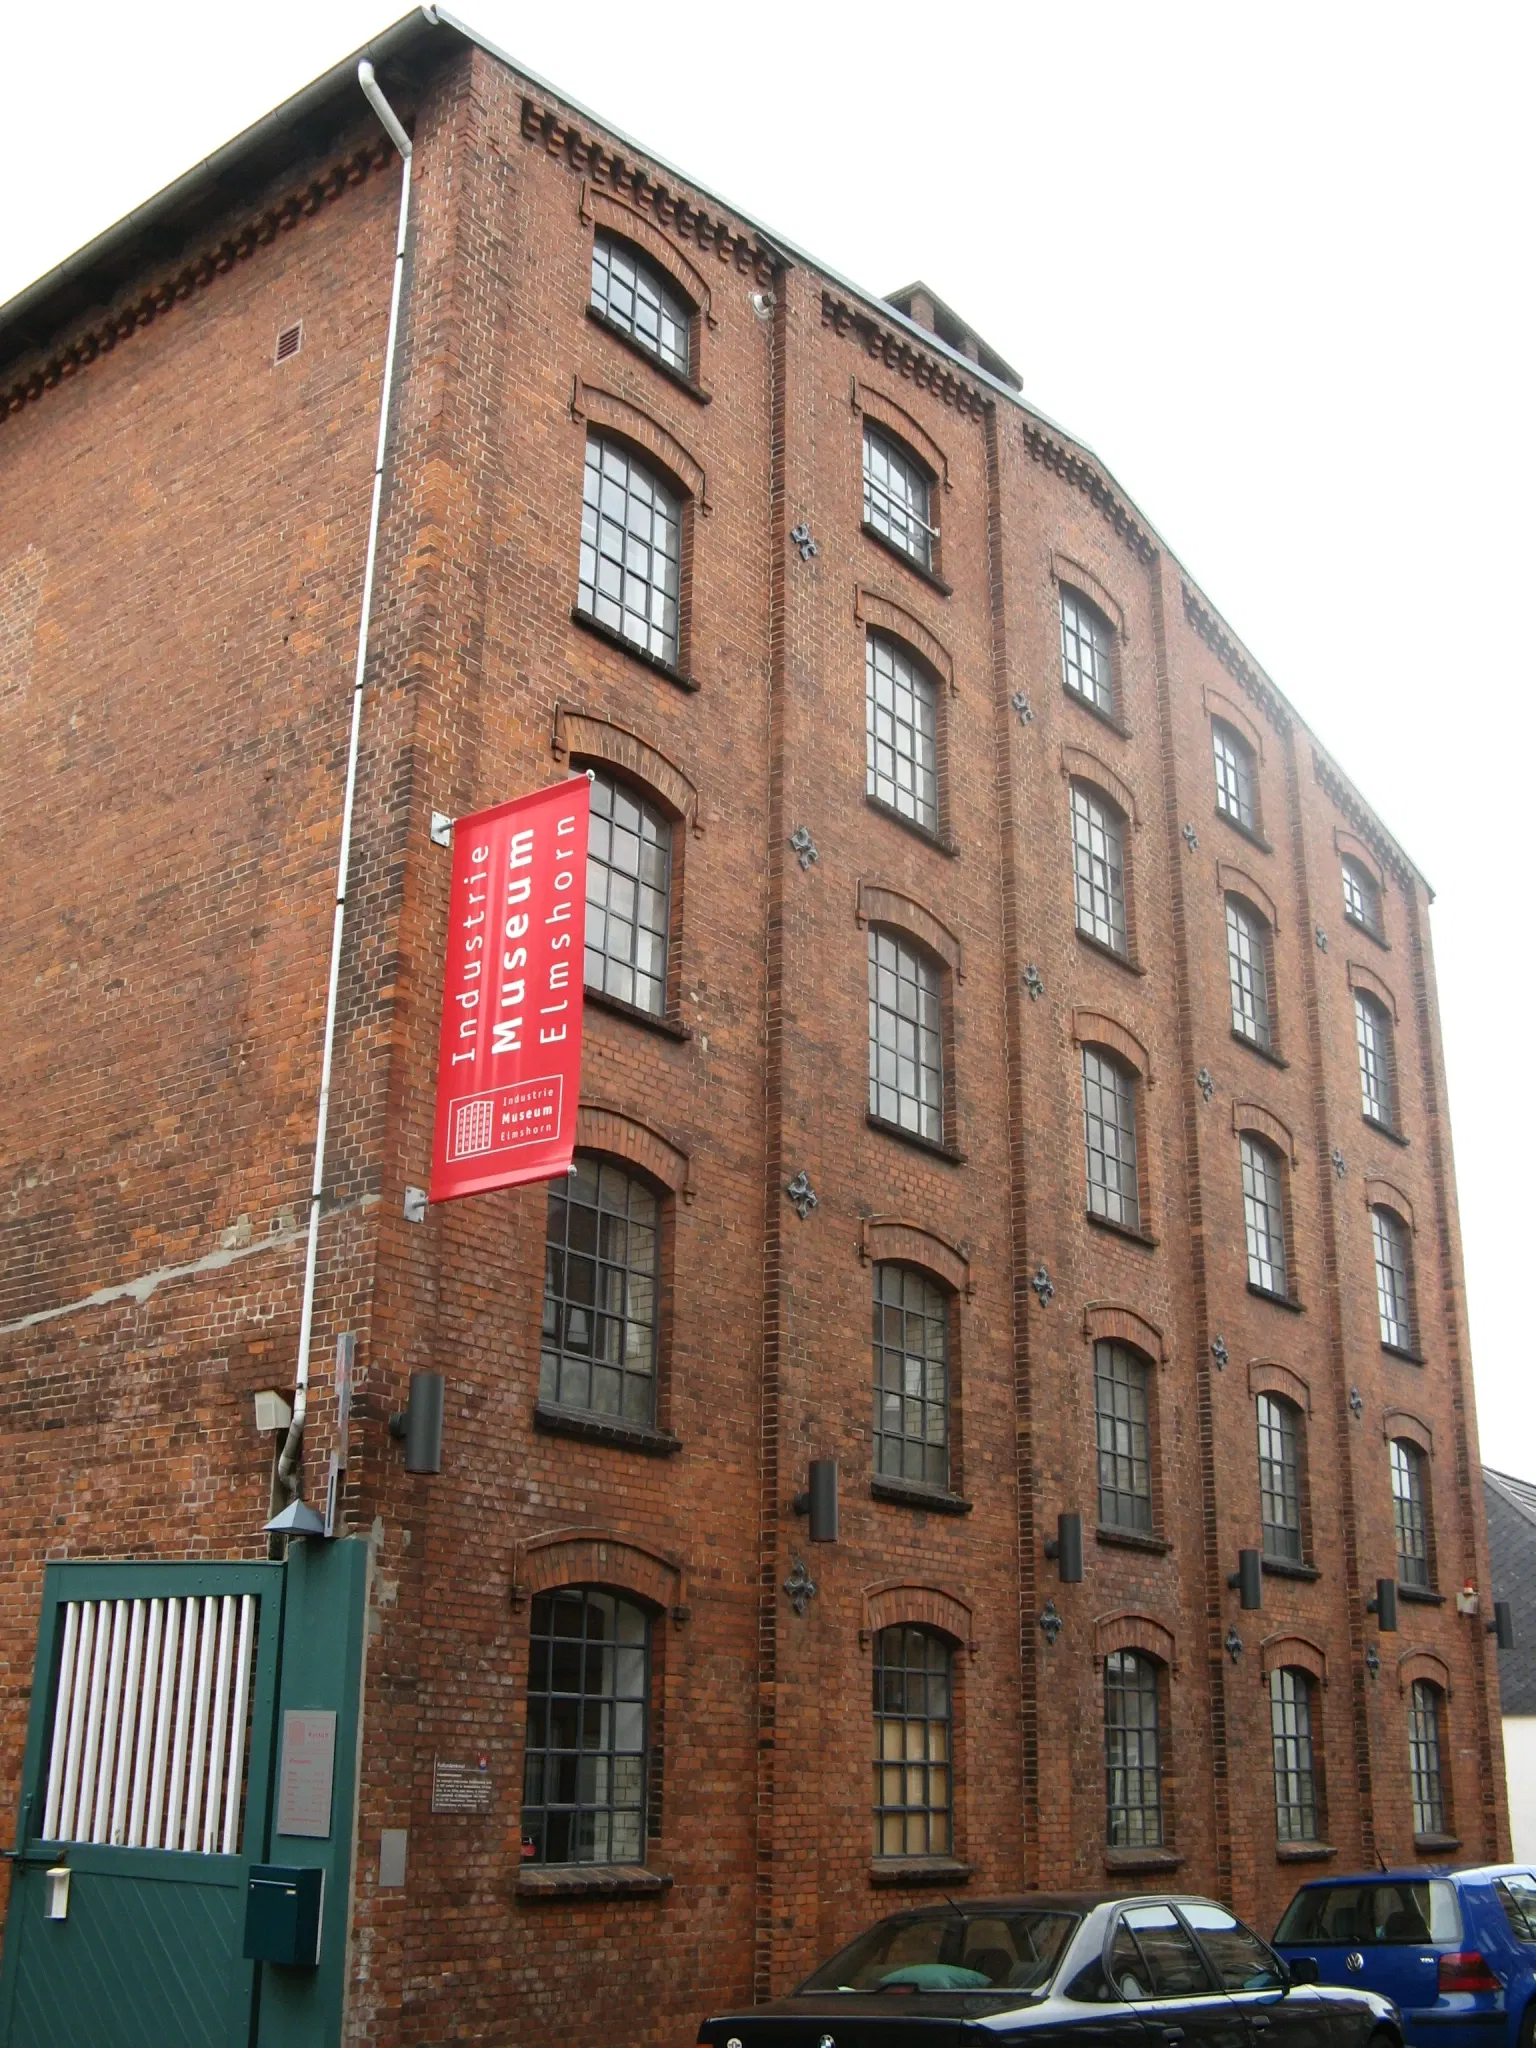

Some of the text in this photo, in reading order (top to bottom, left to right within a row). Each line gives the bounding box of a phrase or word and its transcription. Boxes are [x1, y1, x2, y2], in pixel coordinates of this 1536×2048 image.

[452, 845, 488, 1065] Industrie
[492, 829, 534, 1054] Museum
[540, 815, 575, 1044] Elmshorn
[501, 1124, 551, 1141] Elmshorn
[502, 1106, 553, 1124] Museum
[503, 1088, 553, 1106] Industrie
